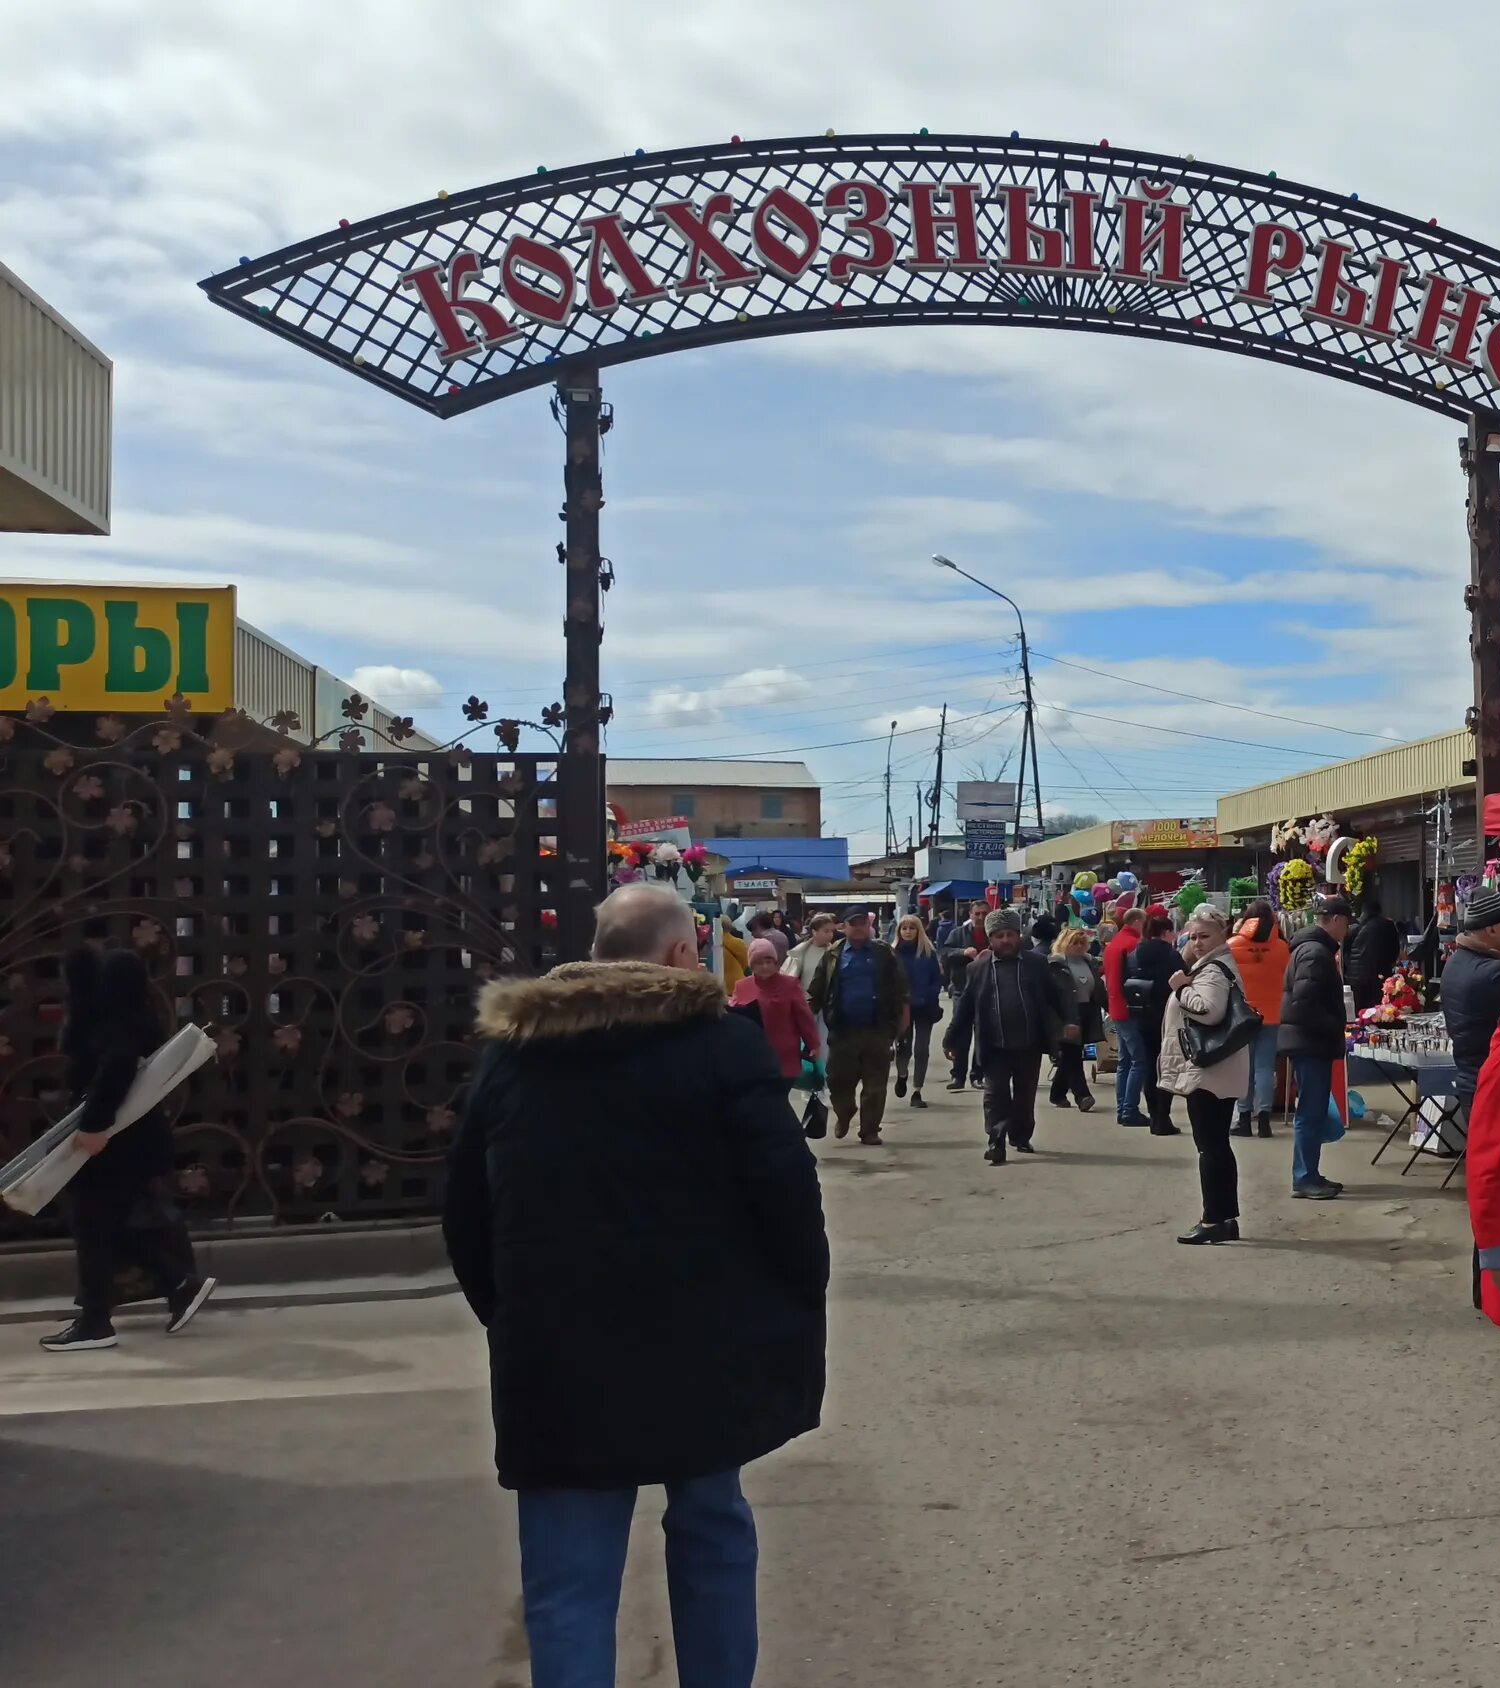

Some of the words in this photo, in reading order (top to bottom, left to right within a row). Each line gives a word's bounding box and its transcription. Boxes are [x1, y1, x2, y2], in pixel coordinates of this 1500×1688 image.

[401, 176, 1191, 364] КОЛХОЗНЫЙ
[0, 597, 209, 693] РЫ
[1153, 821, 1177, 832] 1000
[966, 842, 1005, 851] СТЕКЛО
[737, 880, 775, 888] ТУАЛЕТ
